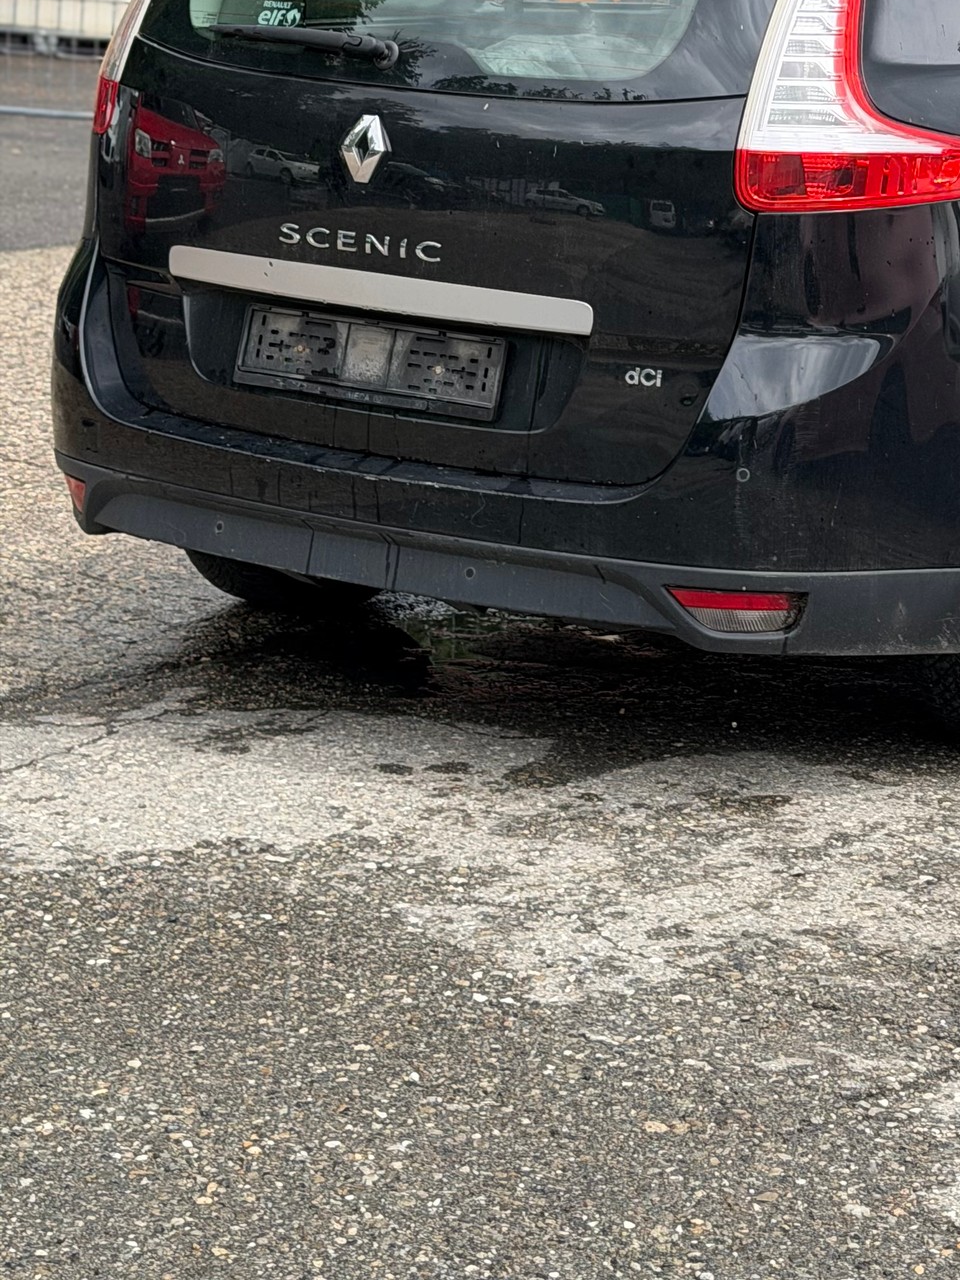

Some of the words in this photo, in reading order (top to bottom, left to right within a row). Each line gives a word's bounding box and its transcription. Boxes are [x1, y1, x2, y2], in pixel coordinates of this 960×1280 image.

[258, 9, 287, 26] elf
[279, 223, 442, 262] SCENIC
[625, 367, 662, 387] dCi
